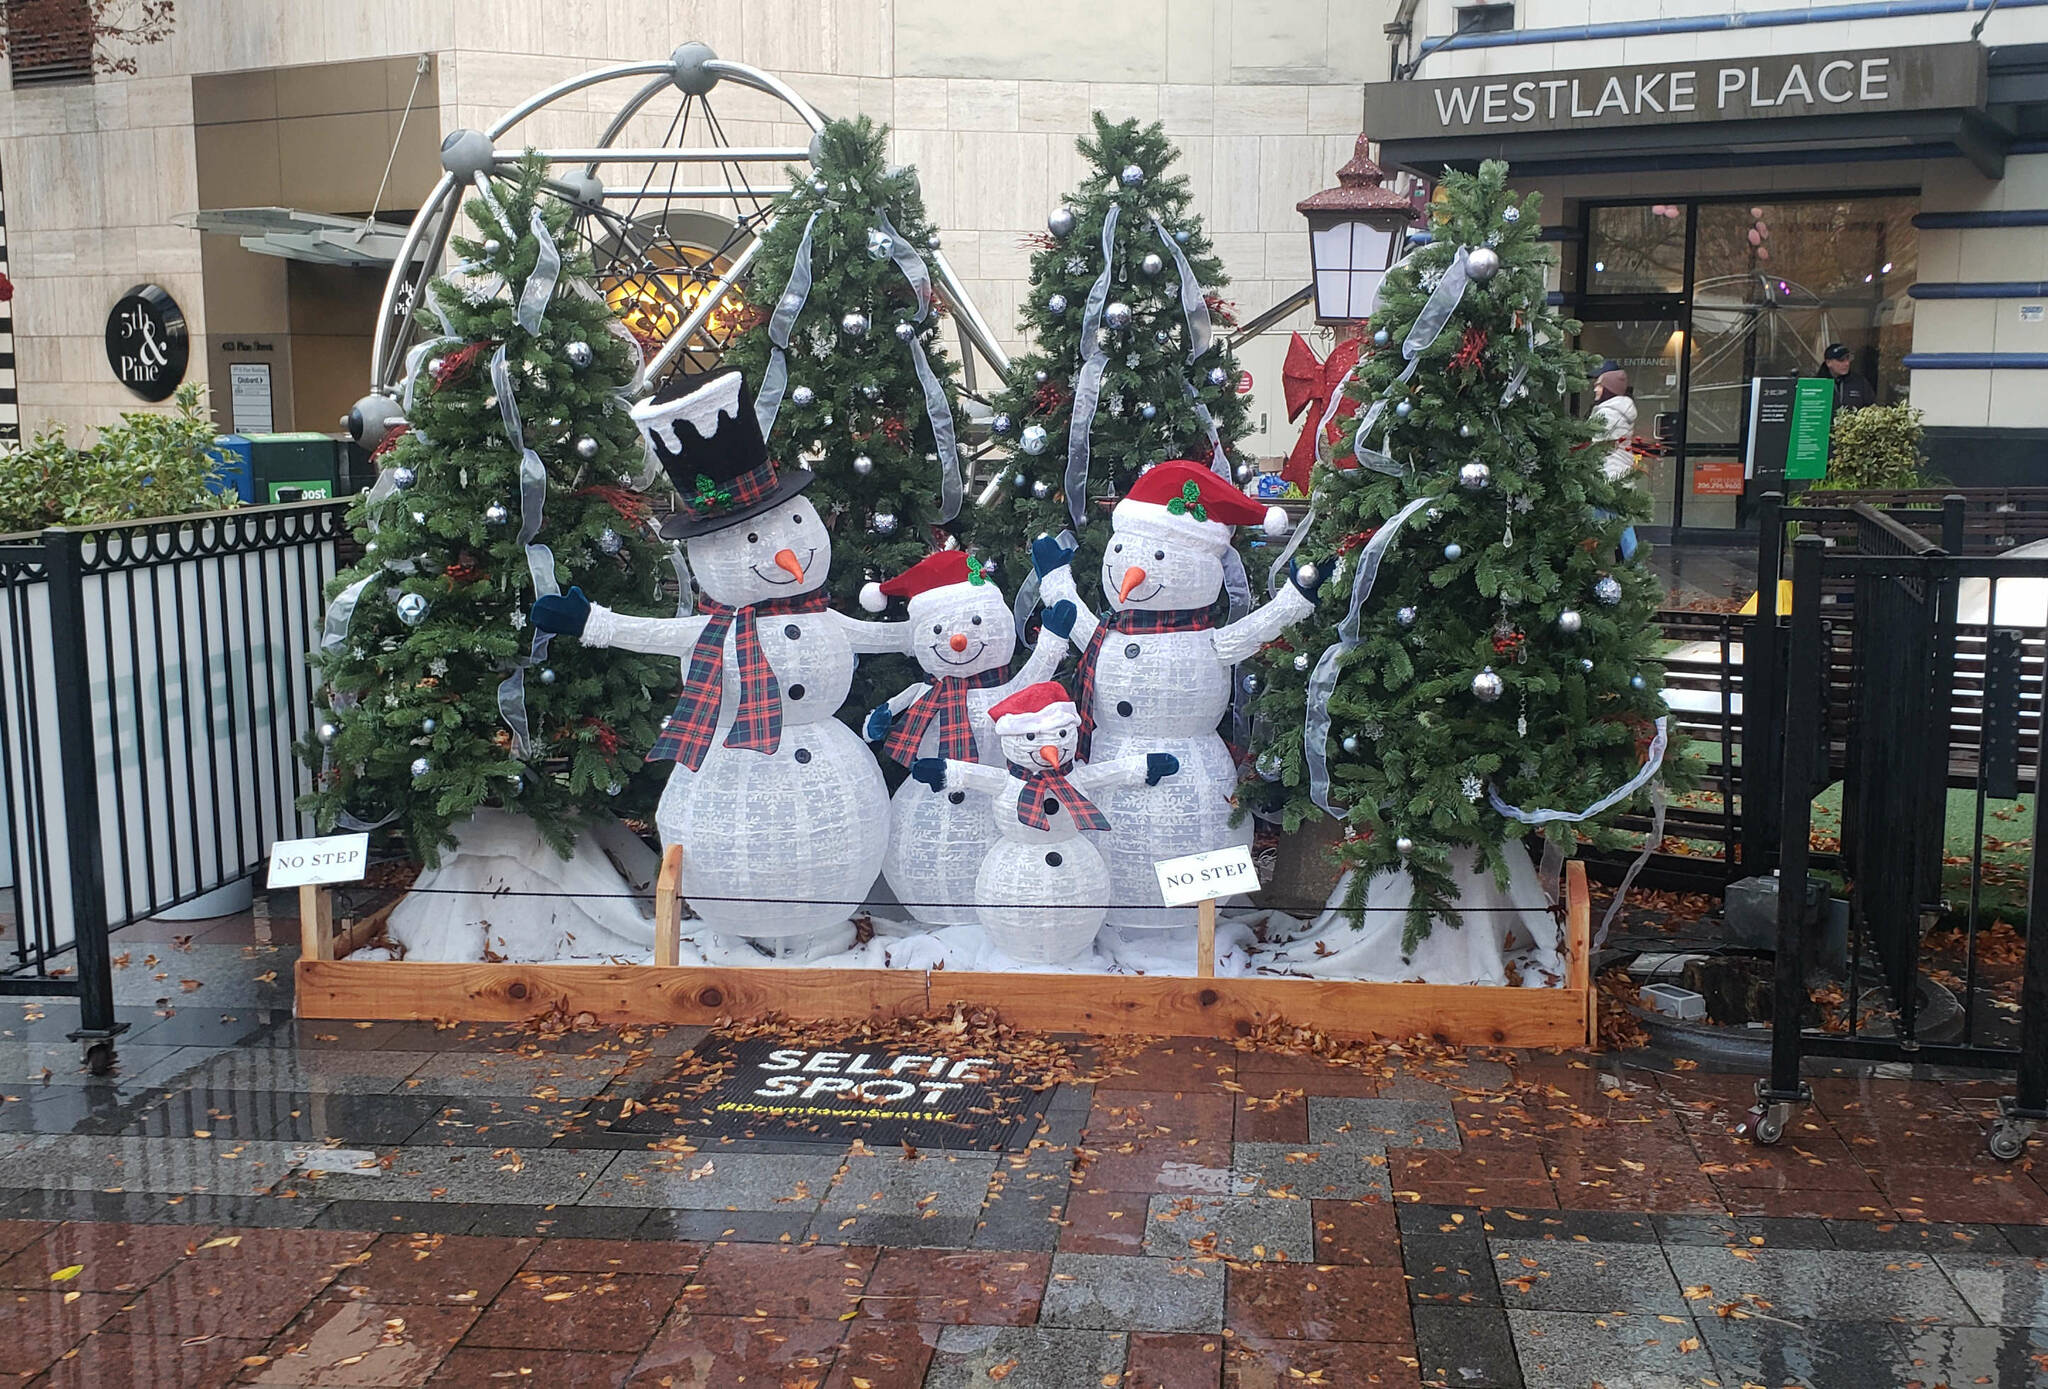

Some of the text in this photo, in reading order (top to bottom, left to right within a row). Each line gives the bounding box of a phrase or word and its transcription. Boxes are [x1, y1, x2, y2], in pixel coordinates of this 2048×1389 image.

[1434, 57, 1890, 126] WESTLAKE PLACE
[121, 304, 168, 366] 5th &
[121, 356, 159, 381] Pine
[277, 850, 359, 869] NO STEP
[1167, 862, 1247, 888] NO STEP
[758, 1050, 993, 1079] SELFIE
[754, 1075, 964, 1104] SPOT
